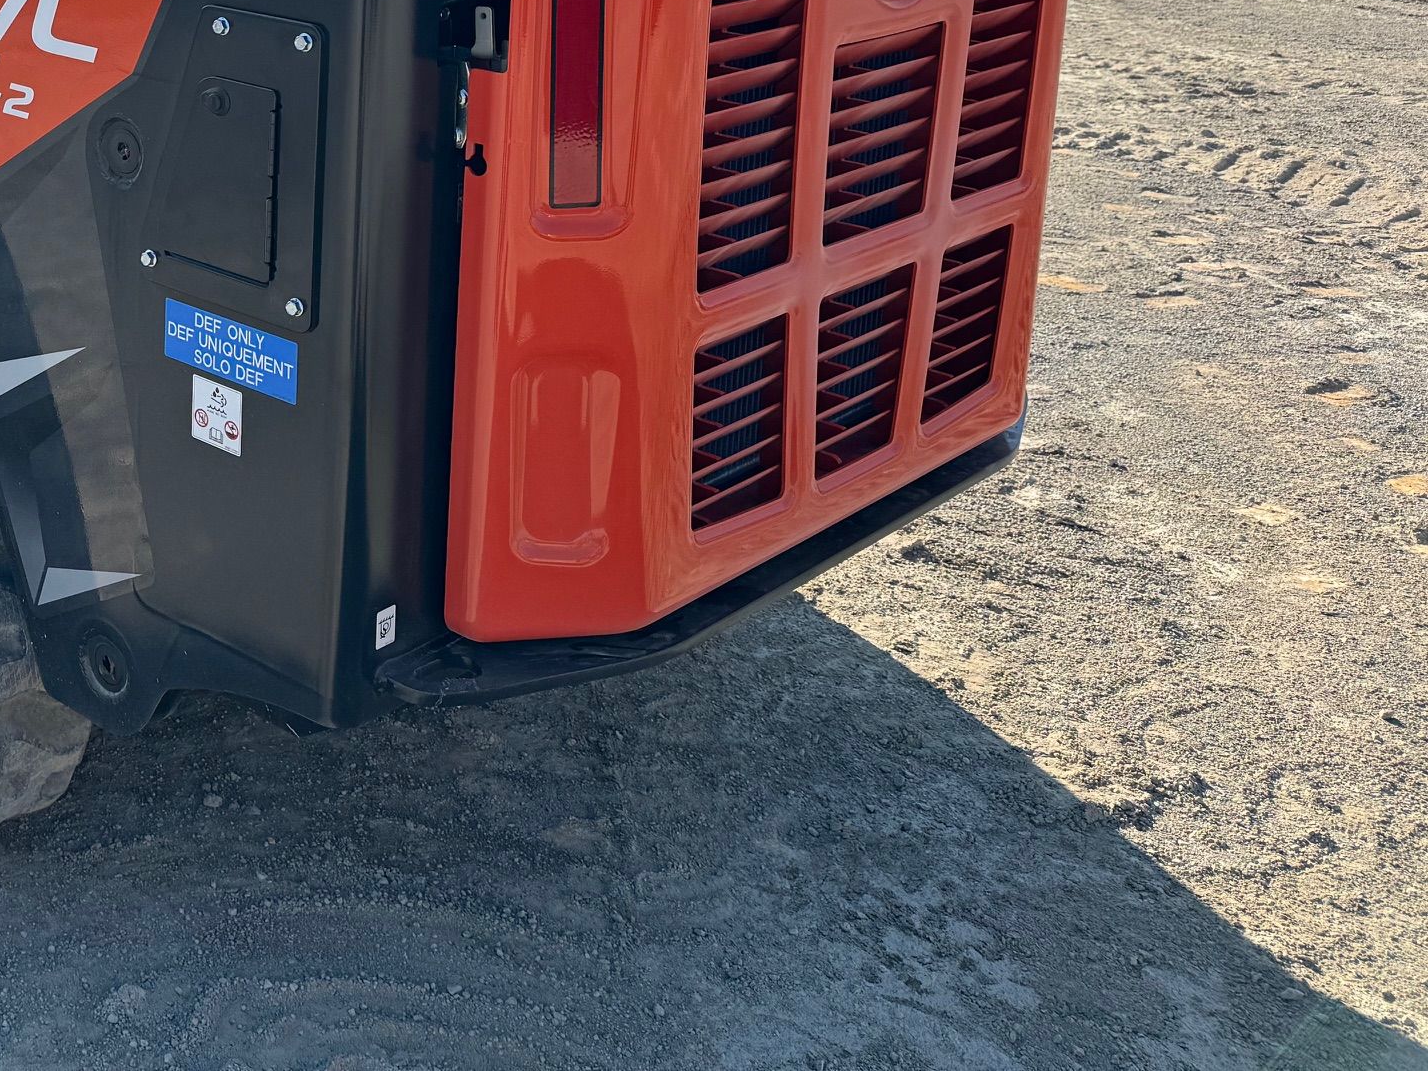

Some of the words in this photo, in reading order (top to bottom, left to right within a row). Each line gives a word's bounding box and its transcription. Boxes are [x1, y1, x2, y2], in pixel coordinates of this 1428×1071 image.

[167, 320, 195, 342] DEF
[198, 332, 294, 379] UNIQUEMENT
[194, 312, 222, 334] DEF
[227, 324, 265, 350] ONLY
[194, 349, 231, 375] SOLO
[235, 364, 264, 387] DEF
